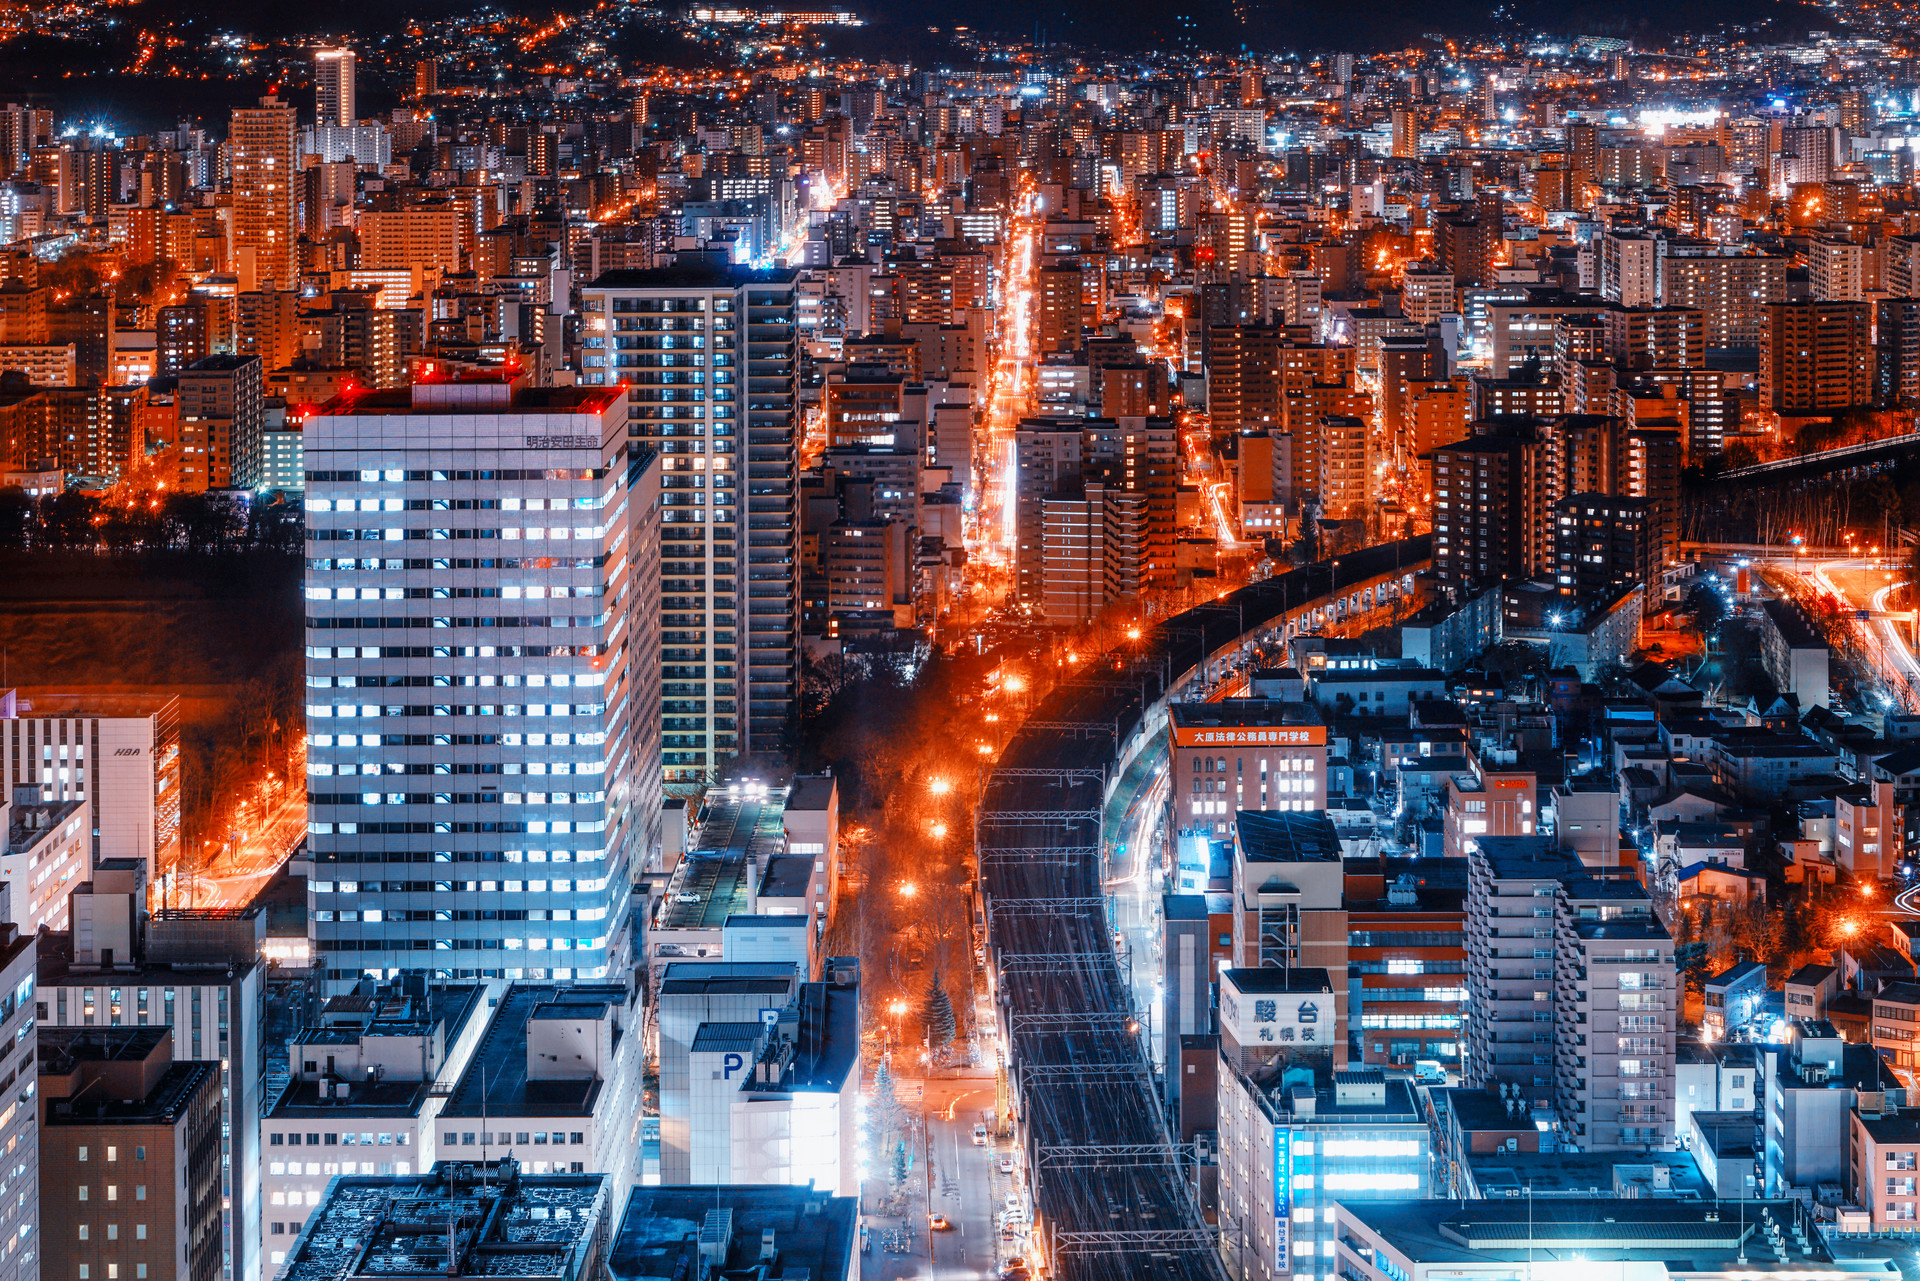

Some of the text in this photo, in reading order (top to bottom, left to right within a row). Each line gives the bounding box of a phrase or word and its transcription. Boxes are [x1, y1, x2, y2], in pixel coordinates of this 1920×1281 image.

[526, 436, 598, 449] 明治安田生命
[1194, 731, 1310, 742] 大原法律公務員専門学校
[1253, 999, 1319, 1023] 駿台
[1258, 1026, 1316, 1042] 札幌校
[724, 1053, 743, 1080] P
